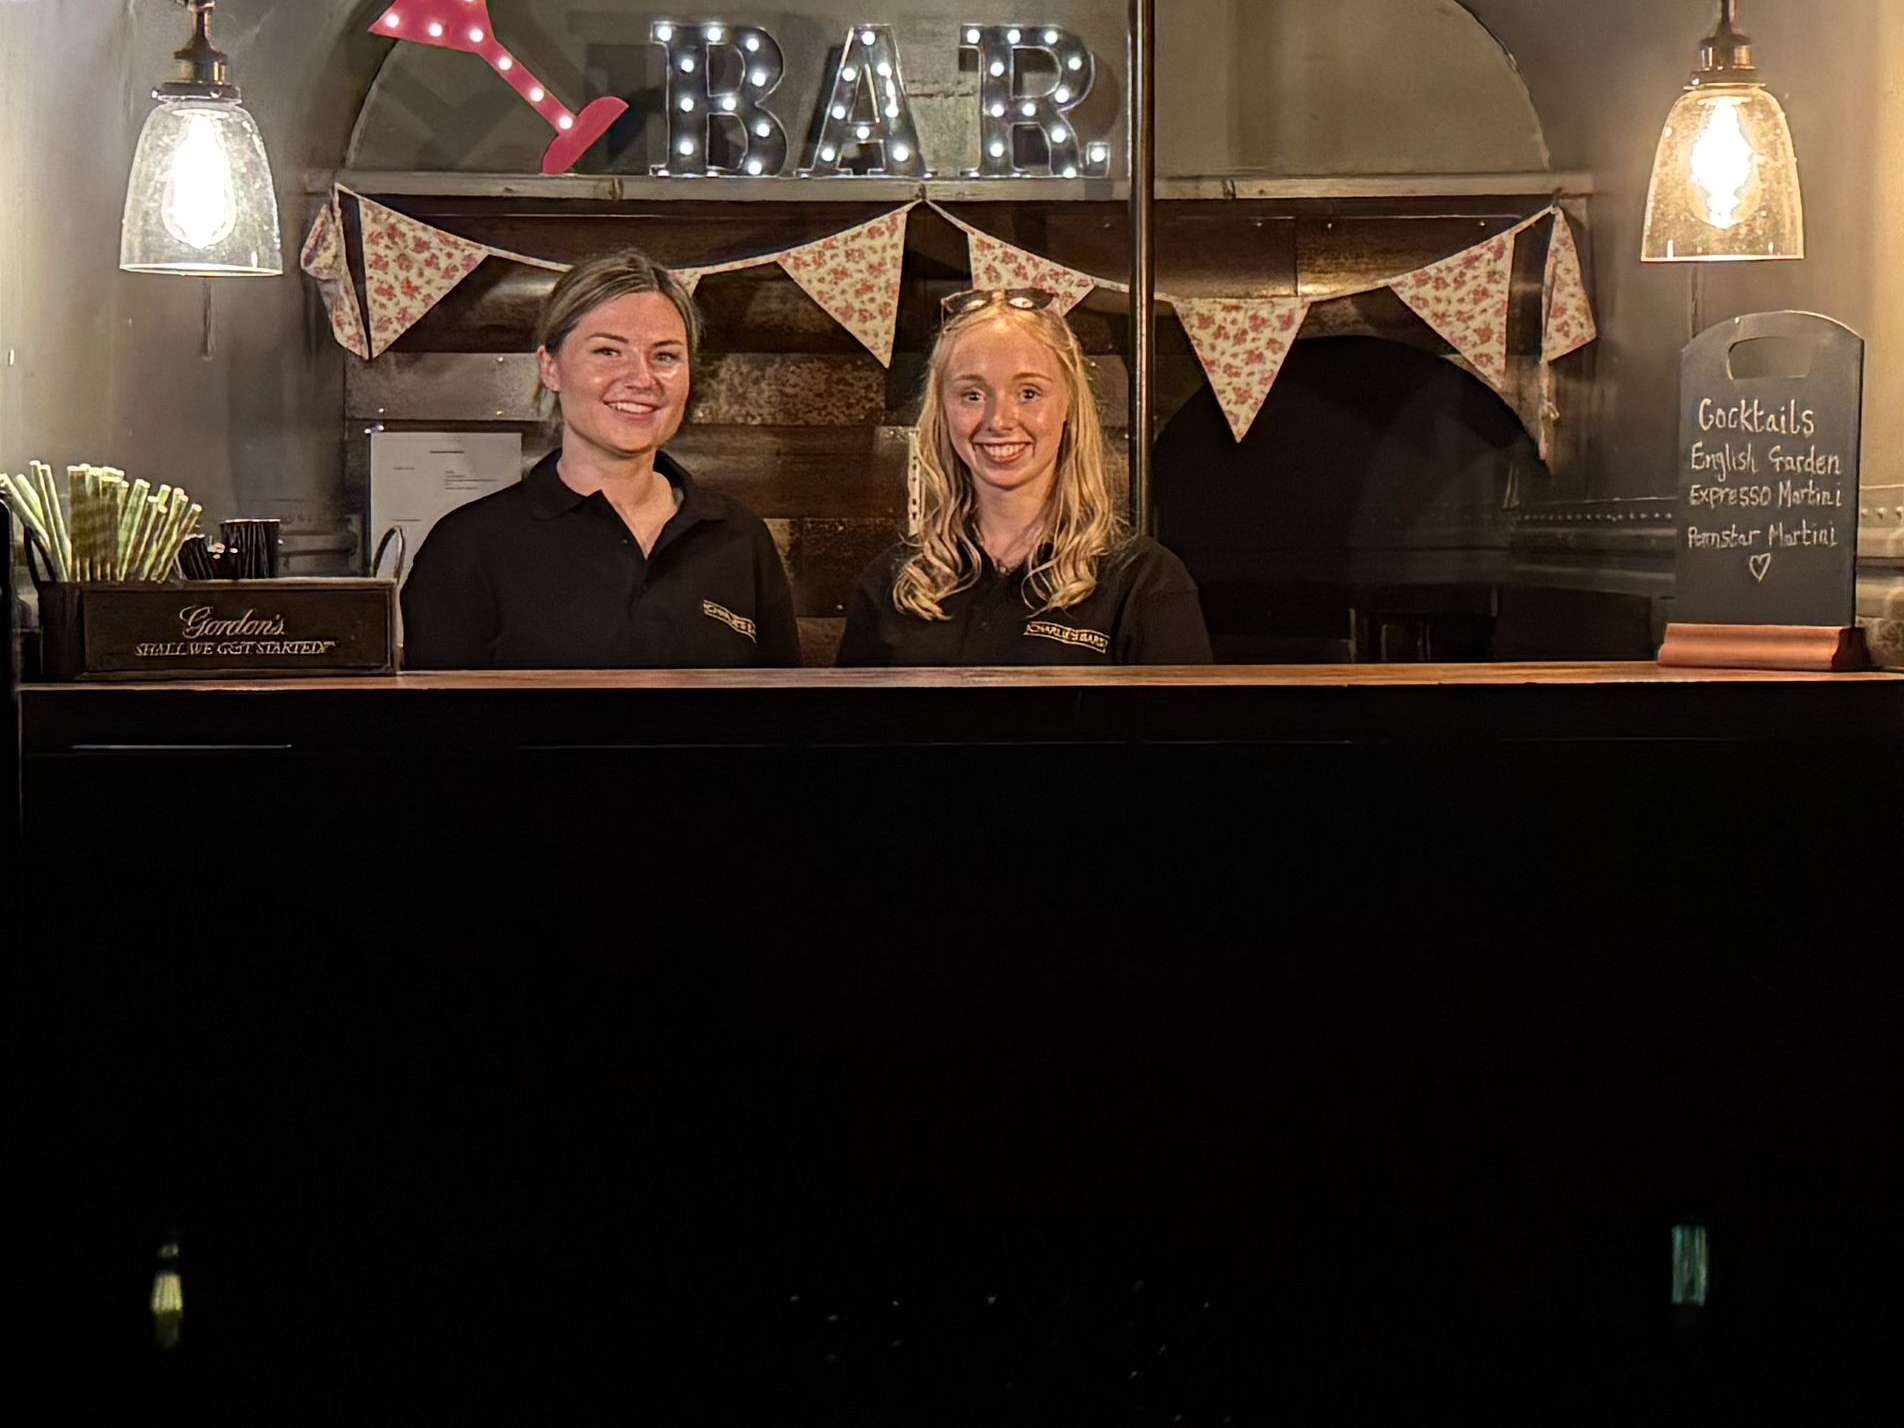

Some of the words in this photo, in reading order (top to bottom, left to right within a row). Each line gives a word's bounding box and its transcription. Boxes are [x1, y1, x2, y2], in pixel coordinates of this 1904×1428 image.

[649, 21, 1111, 177] BAR
[1698, 397, 1815, 439] Cocktails
[1690, 441, 1759, 483] English
[1768, 444, 1842, 475] Garden
[1778, 478, 1843, 509] Martini
[179, 605, 288, 639] Gordon's
